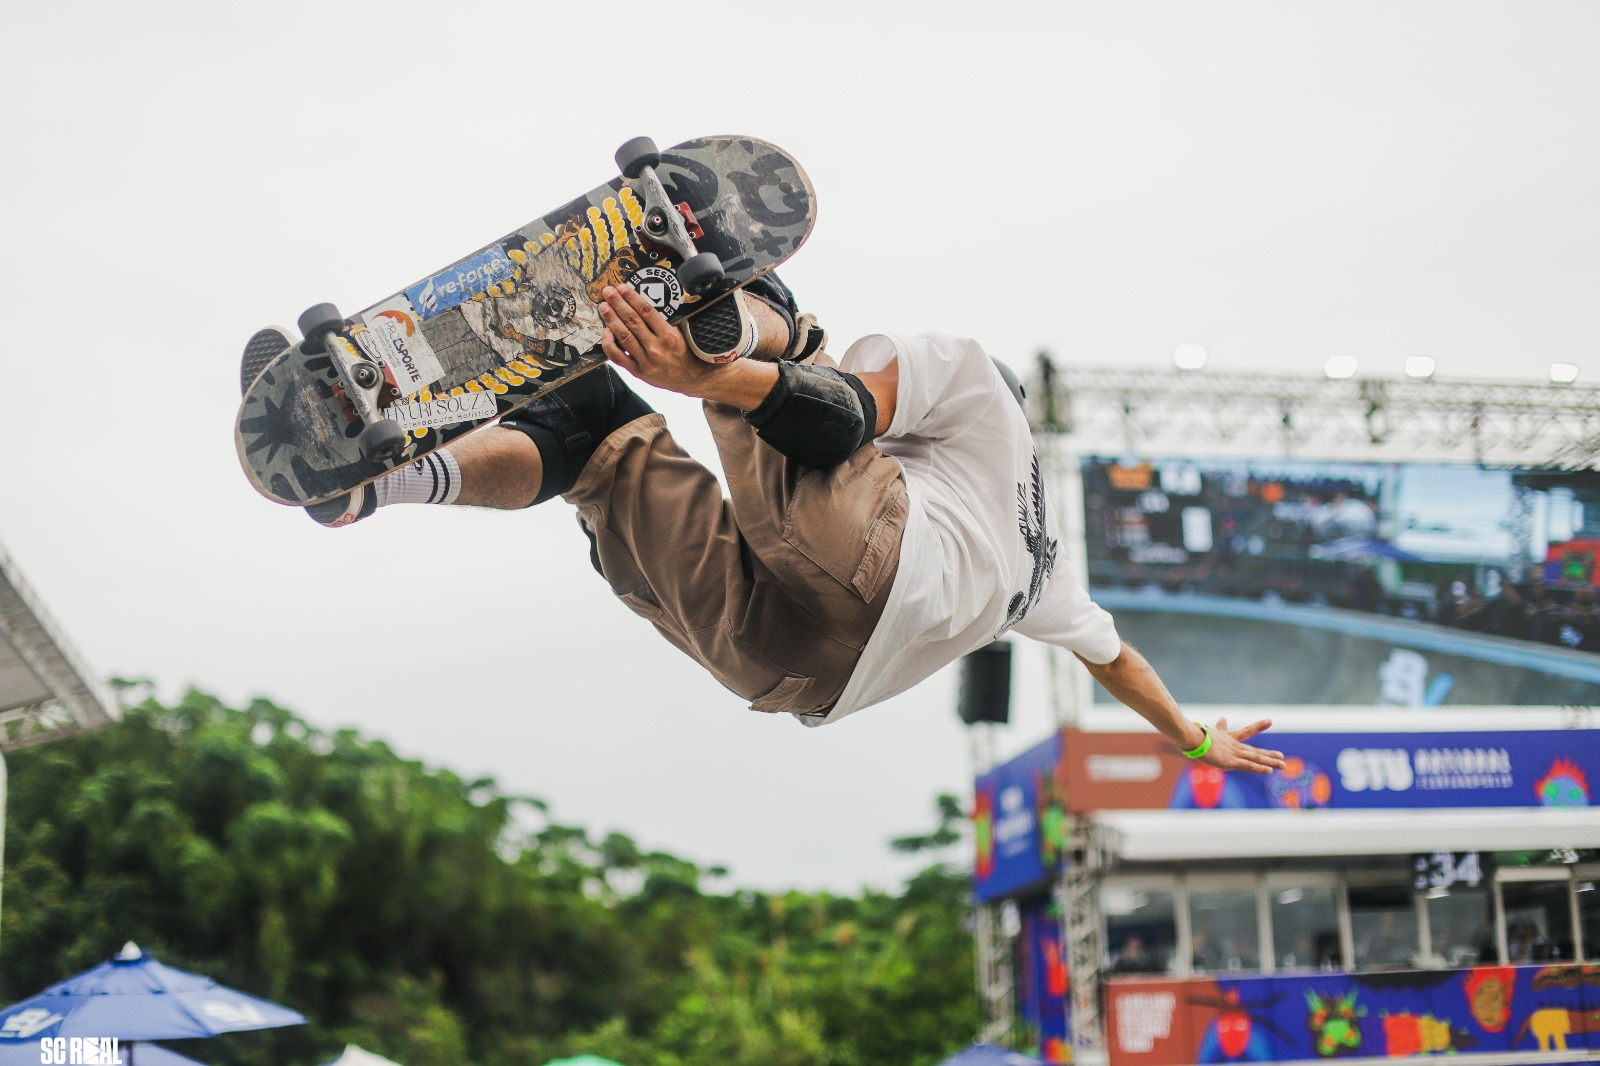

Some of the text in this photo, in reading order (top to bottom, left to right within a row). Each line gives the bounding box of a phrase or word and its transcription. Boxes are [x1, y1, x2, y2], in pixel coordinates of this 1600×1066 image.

[645, 268, 680, 302] SESSION
[386, 401, 432, 422] HYURI
[436, 392, 495, 415] SOUZA
[1337, 748, 1511, 791] STU NATIONAL
